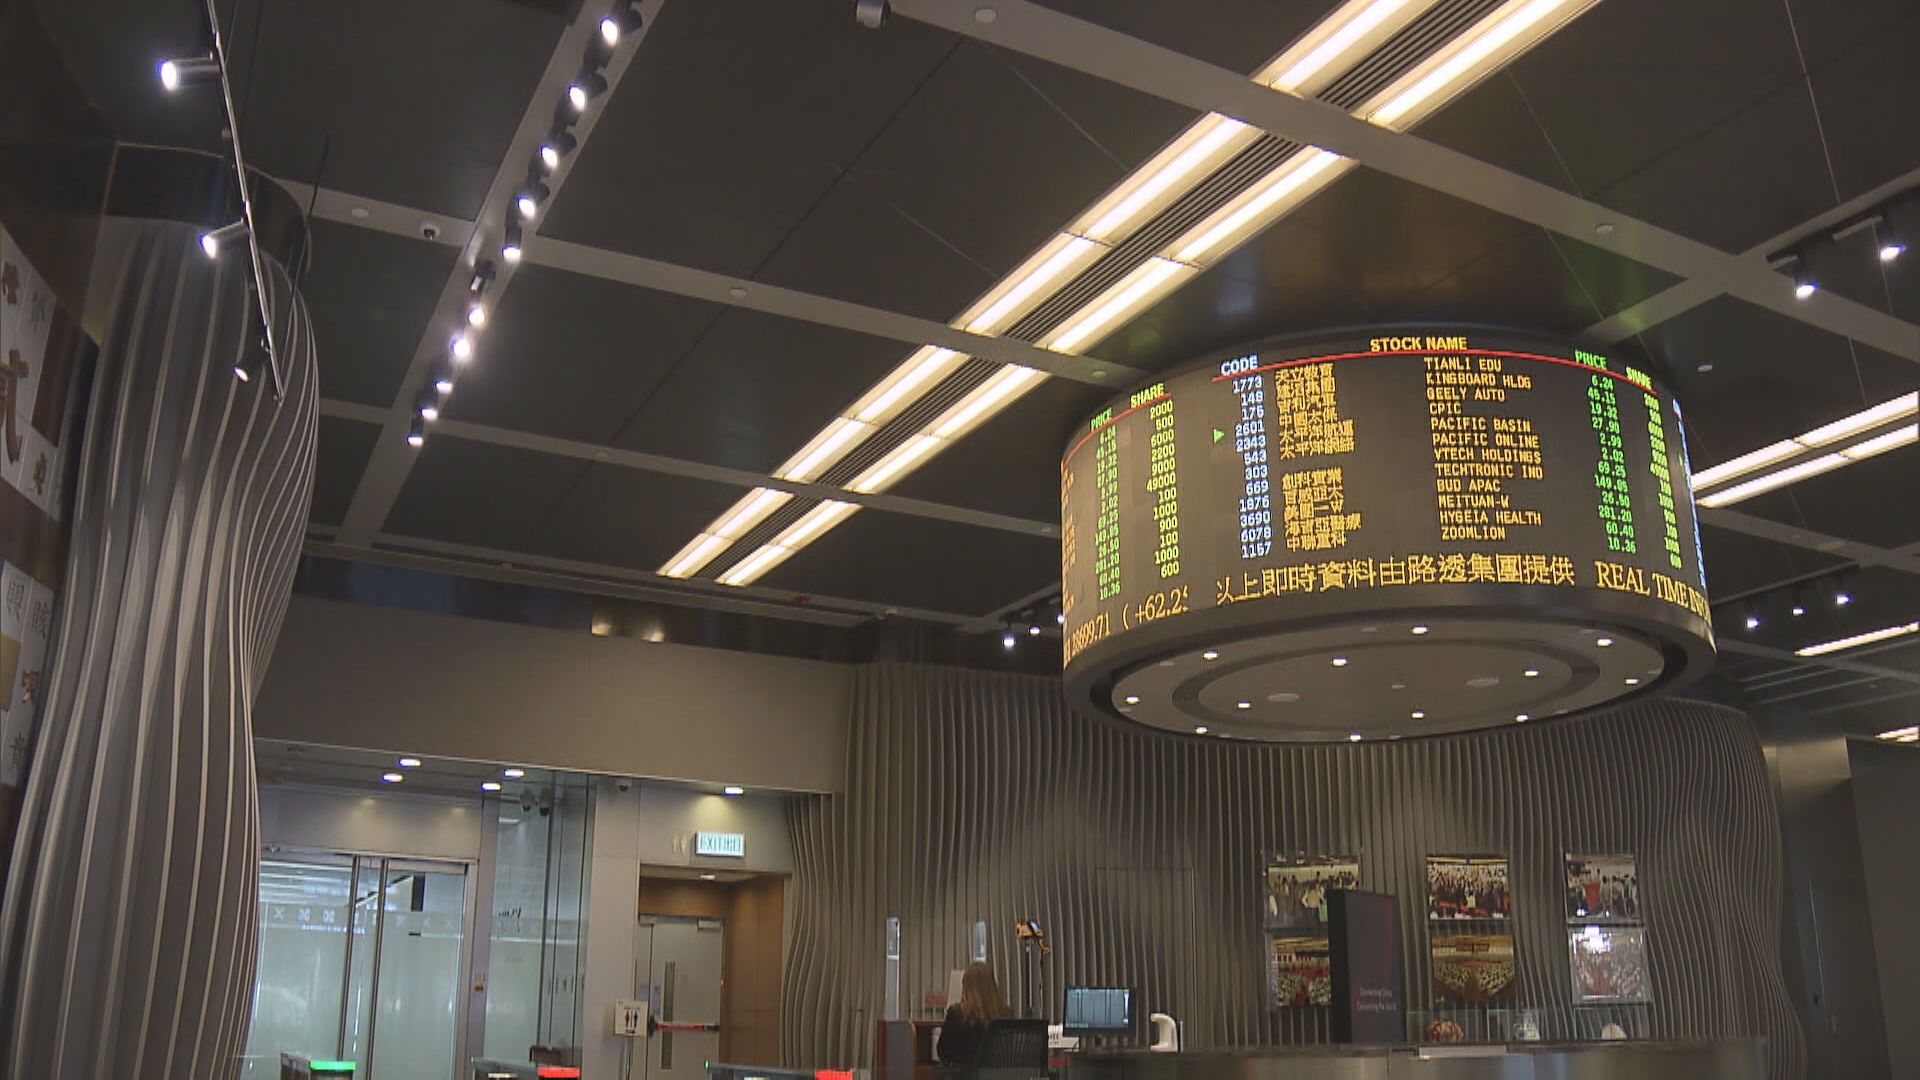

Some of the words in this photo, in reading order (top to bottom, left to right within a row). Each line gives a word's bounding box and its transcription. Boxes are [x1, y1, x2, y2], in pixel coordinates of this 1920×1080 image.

[1370, 338, 1422, 352] STOCK
[1426, 337, 1467, 350] NAME
[1221, 355, 1258, 375] CODE
[1424, 357, 1470, 370] TIANLI
[1479, 359, 1501, 371] EDU
[1575, 350, 1606, 370] PRICE
[1233, 375, 1262, 393] 1773
[1426, 373, 1496, 385] KINGBOARD
[1503, 376, 1531, 389] HLDG
[1592, 375, 1613, 390] 6.24
[1626, 367, 1651, 391] SHARE
[1131, 383, 1164, 408] SHARE
[1241, 391, 1263, 405] 148
[1427, 388, 1466, 400] GEELY
[1475, 389, 1504, 401] AUTO
[1588, 387, 1615, 405] 45.15
[1150, 399, 1173, 419] 2000
[1430, 403, 1461, 415] CPIC
[1591, 401, 1617, 420] 19.32
[1091, 407, 1112, 432] PRICE
[1156, 414, 1173, 430] 500
[1431, 417, 1486, 430] PACIFIC
[1493, 418, 1530, 432] BASIN
[1592, 417, 1619, 434] 27.90
[1236, 420, 1264, 437] 2601
[1151, 429, 1174, 447] 6000
[1237, 434, 1266, 452] 2343
[1433, 433, 1487, 446] PACIFIC
[1496, 435, 1540, 448] ONLINE
[1600, 432, 1621, 448] 2.99
[1152, 443, 1175, 462] 2200
[1244, 449, 1267, 465] 543
[1434, 447, 1474, 460] VTECH
[1482, 449, 1541, 464] HOLDINGS
[1602, 447, 1624, 464] 2.02
[1152, 457, 1175, 476] 9000
[1245, 465, 1268, 480] 303
[1435, 463, 1513, 478] TECHTRONIC
[1522, 465, 1543, 479] IND
[1599, 461, 1626, 478] 69.25
[1147, 471, 1176, 492] 49000
[1246, 479, 1269, 495] 669
[1437, 479, 1461, 492] BUD
[1469, 479, 1500, 492] APAC
[1159, 487, 1177, 502] 100
[1439, 495, 1509, 508] MEITUAN-W
[1602, 490, 1630, 508] 26.50
[1154, 501, 1177, 520] 1000
[1240, 495, 1269, 512] 1876
[1240, 511, 1271, 527] 3690
[1440, 510, 1488, 524] HYGEIA
[1496, 511, 1541, 525] HEALTH
[1599, 505, 1632, 523] 281.20
[1160, 515, 1177, 532] 900
[1606, 521, 1634, 538] 60.40
[1160, 531, 1178, 548] 100
[1241, 525, 1271, 542] 6078
[1442, 526, 1505, 540] ZOOMLION
[1608, 537, 1636, 554] 10.36
[1155, 545, 1178, 564] 1000
[1161, 561, 1179, 578] 600
[1216, 552, 1575, 607] 以上即時資料由路透集團提供
[1595, 561, 1650, 595] REAL
[1652, 572, 1688, 608] TIME
